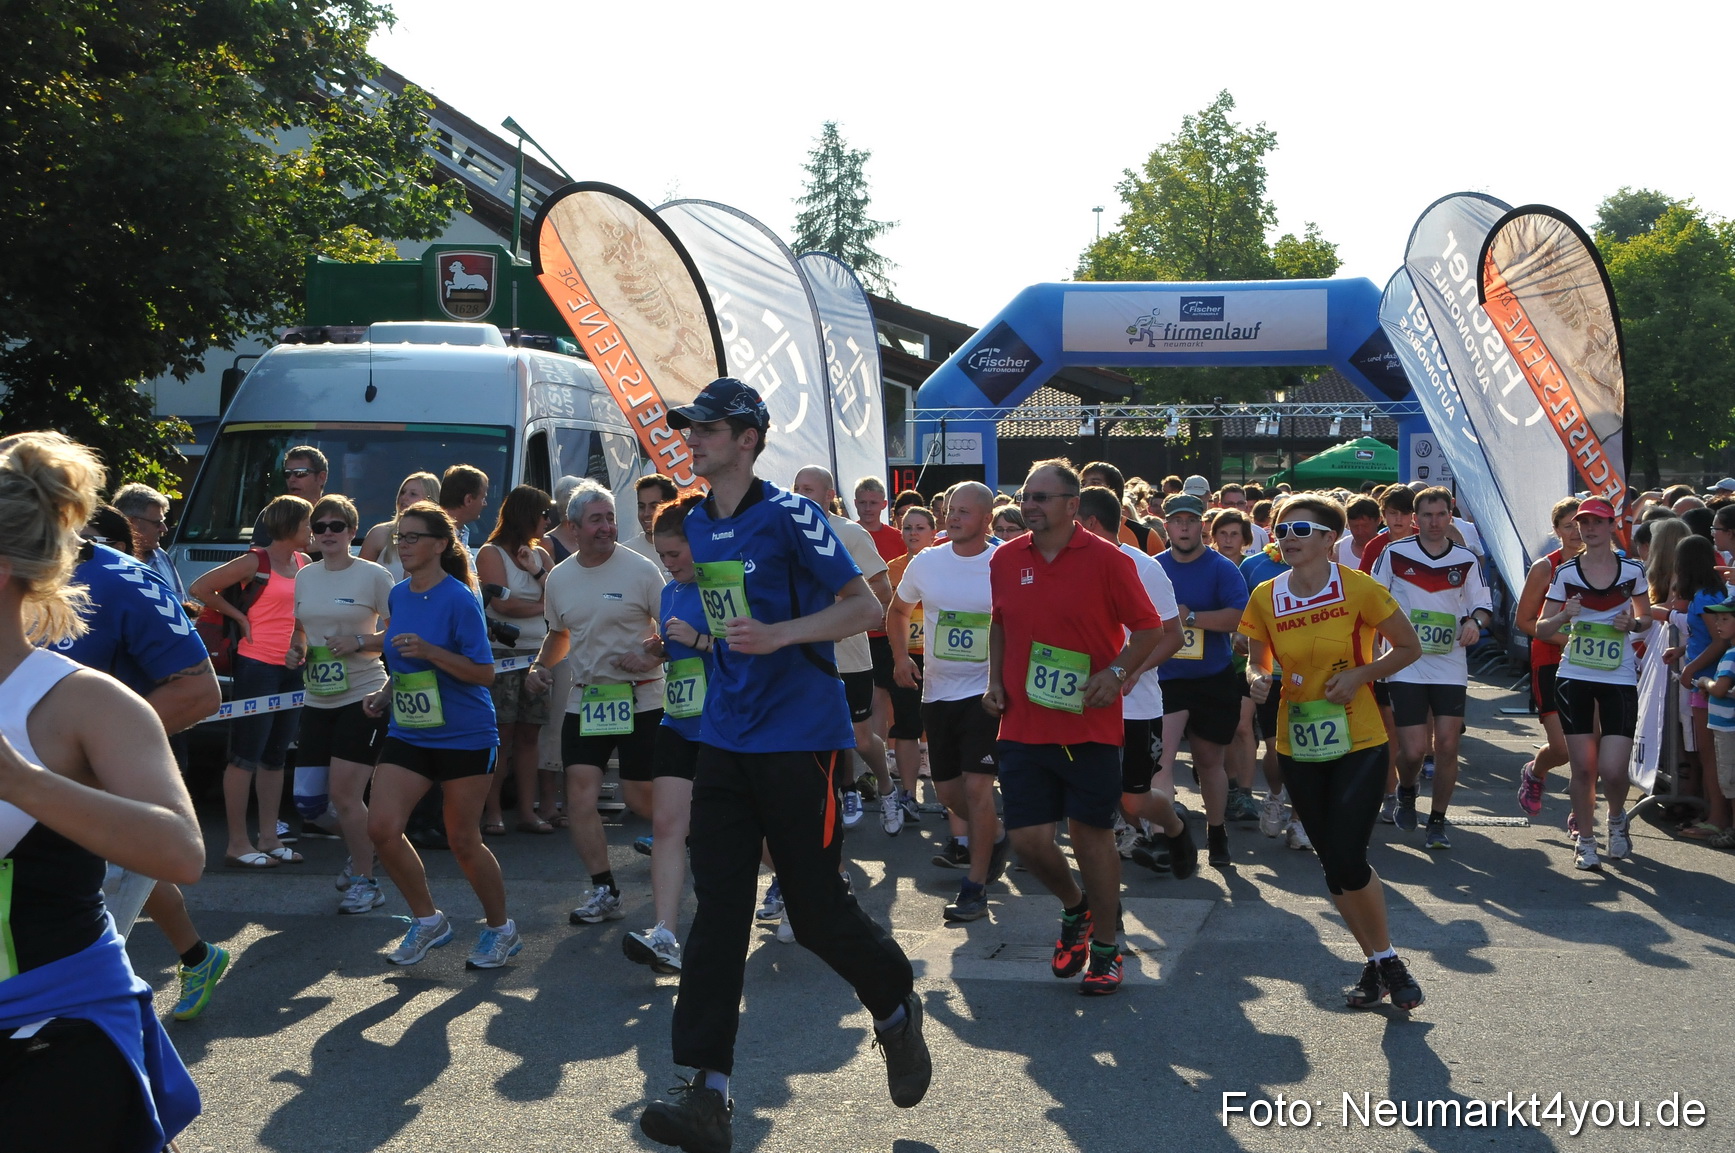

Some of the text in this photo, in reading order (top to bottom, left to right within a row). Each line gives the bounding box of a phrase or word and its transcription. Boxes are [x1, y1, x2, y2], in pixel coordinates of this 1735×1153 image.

[454, 303, 480, 314] 1628
[1189, 305, 1222, 314] Fischer
[1164, 321, 1262, 340] firmenlauf
[978, 356, 1030, 367] Fischer
[711, 528, 735, 541] hummel
[703, 588, 738, 620] 691
[1276, 607, 1350, 633] MAX BÖGL
[948, 627, 974, 649] 66
[1573, 636, 1620, 660] 1316
[305, 661, 345, 683] 1423
[1034, 665, 1078, 697] 813
[396, 691, 430, 715] 630
[667, 679, 696, 705] 627
[582, 701, 631, 723] 1418
[1293, 721, 1340, 747] 812
